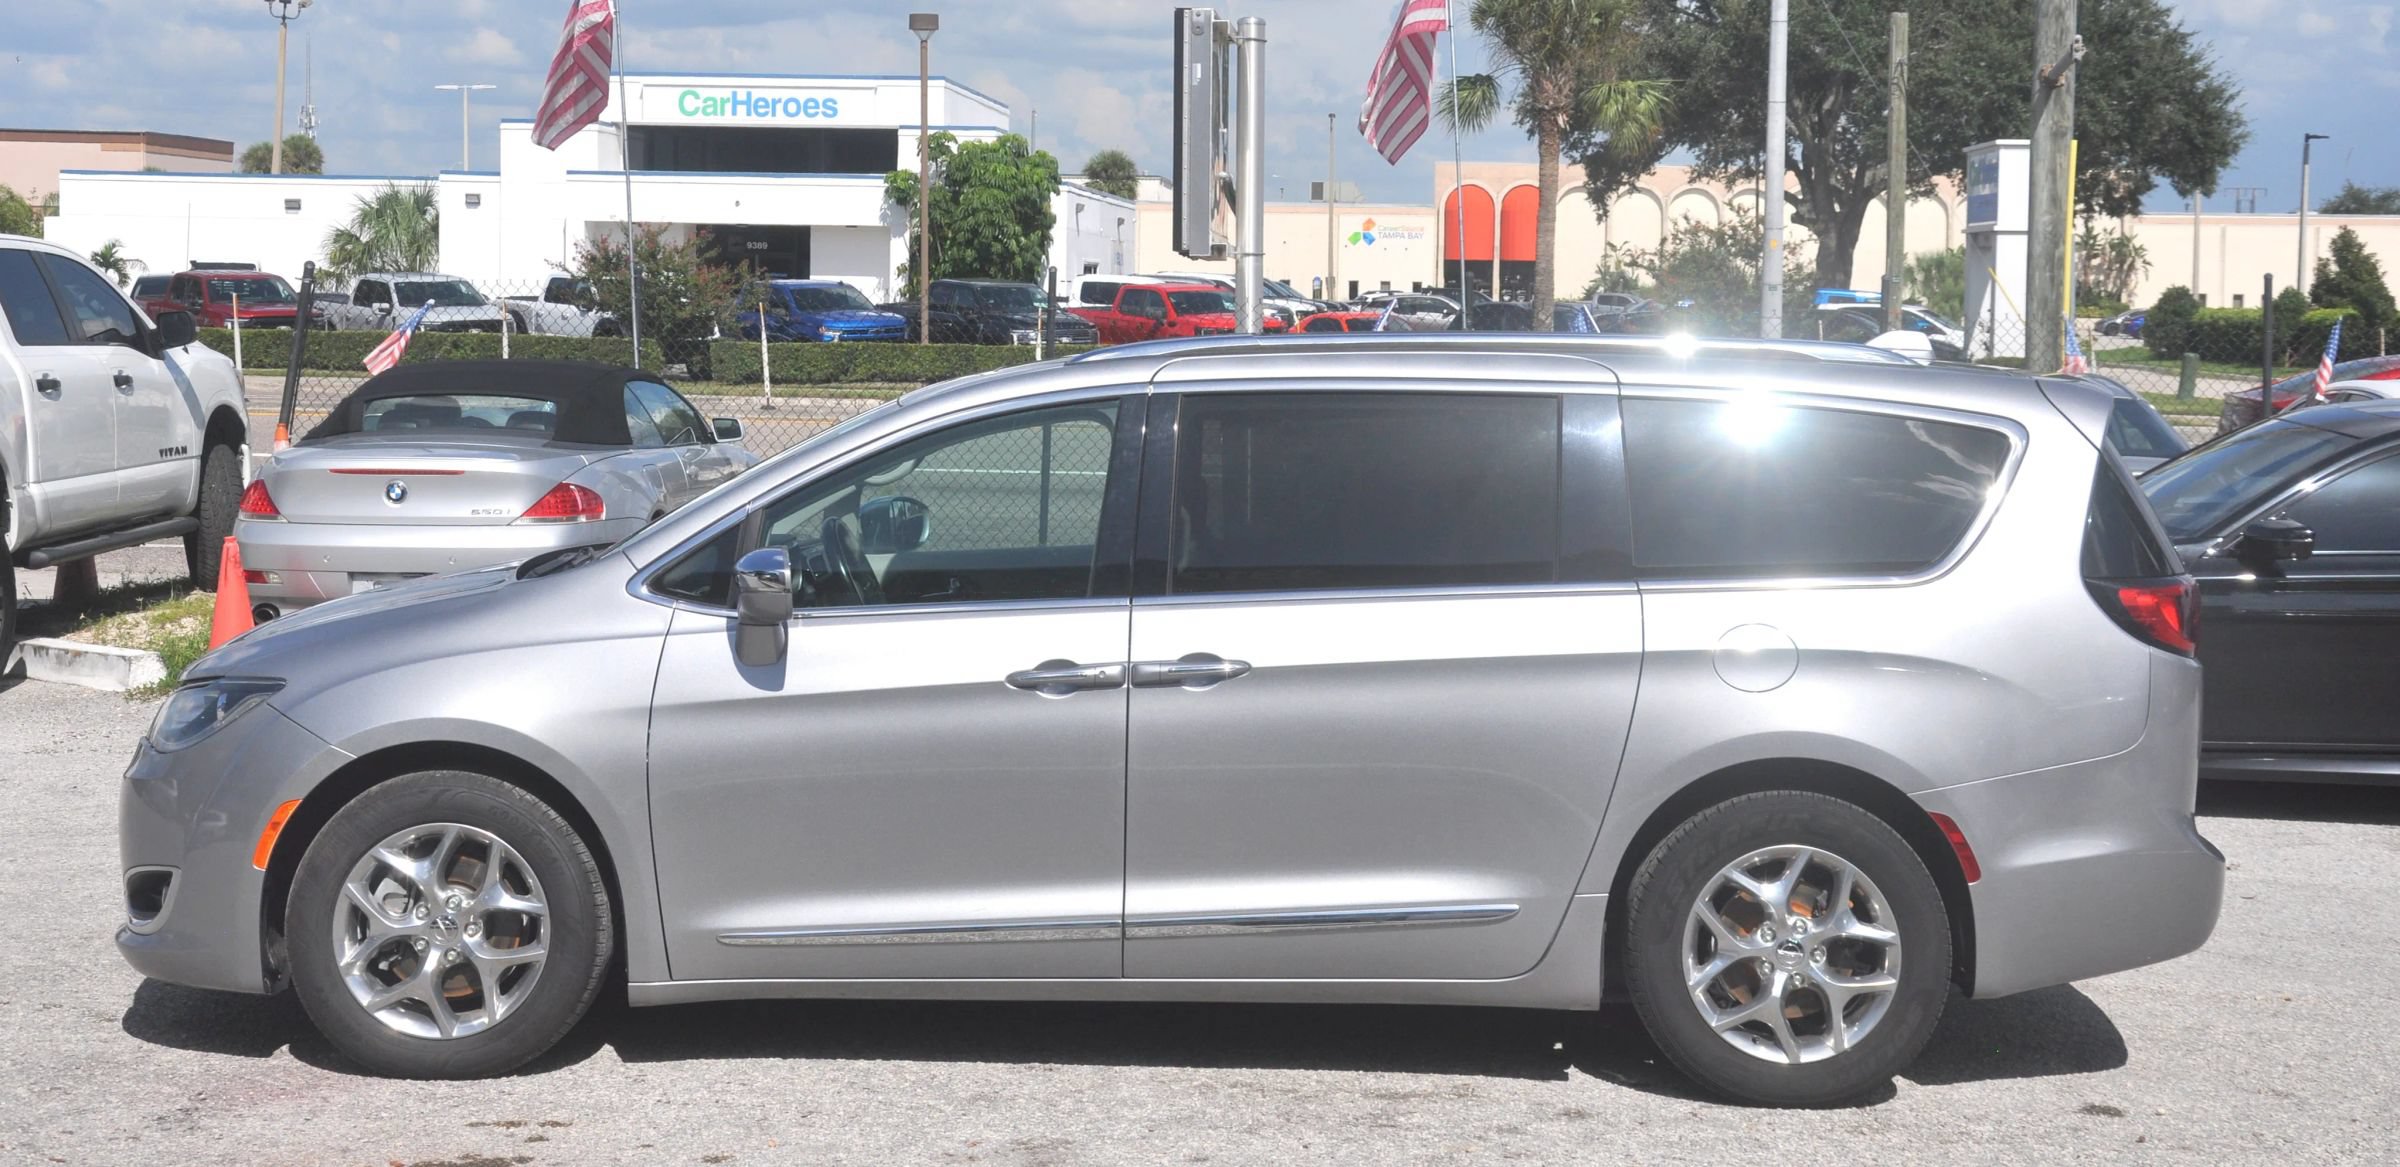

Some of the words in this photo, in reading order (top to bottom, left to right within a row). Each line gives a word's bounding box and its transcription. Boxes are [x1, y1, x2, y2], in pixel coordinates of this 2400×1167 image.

[678, 89, 838, 118] CarHeroes
[1378, 231, 1406, 240] TAMPA
[1408, 232, 1424, 240] BAY
[159, 445, 187, 458] TITAN
